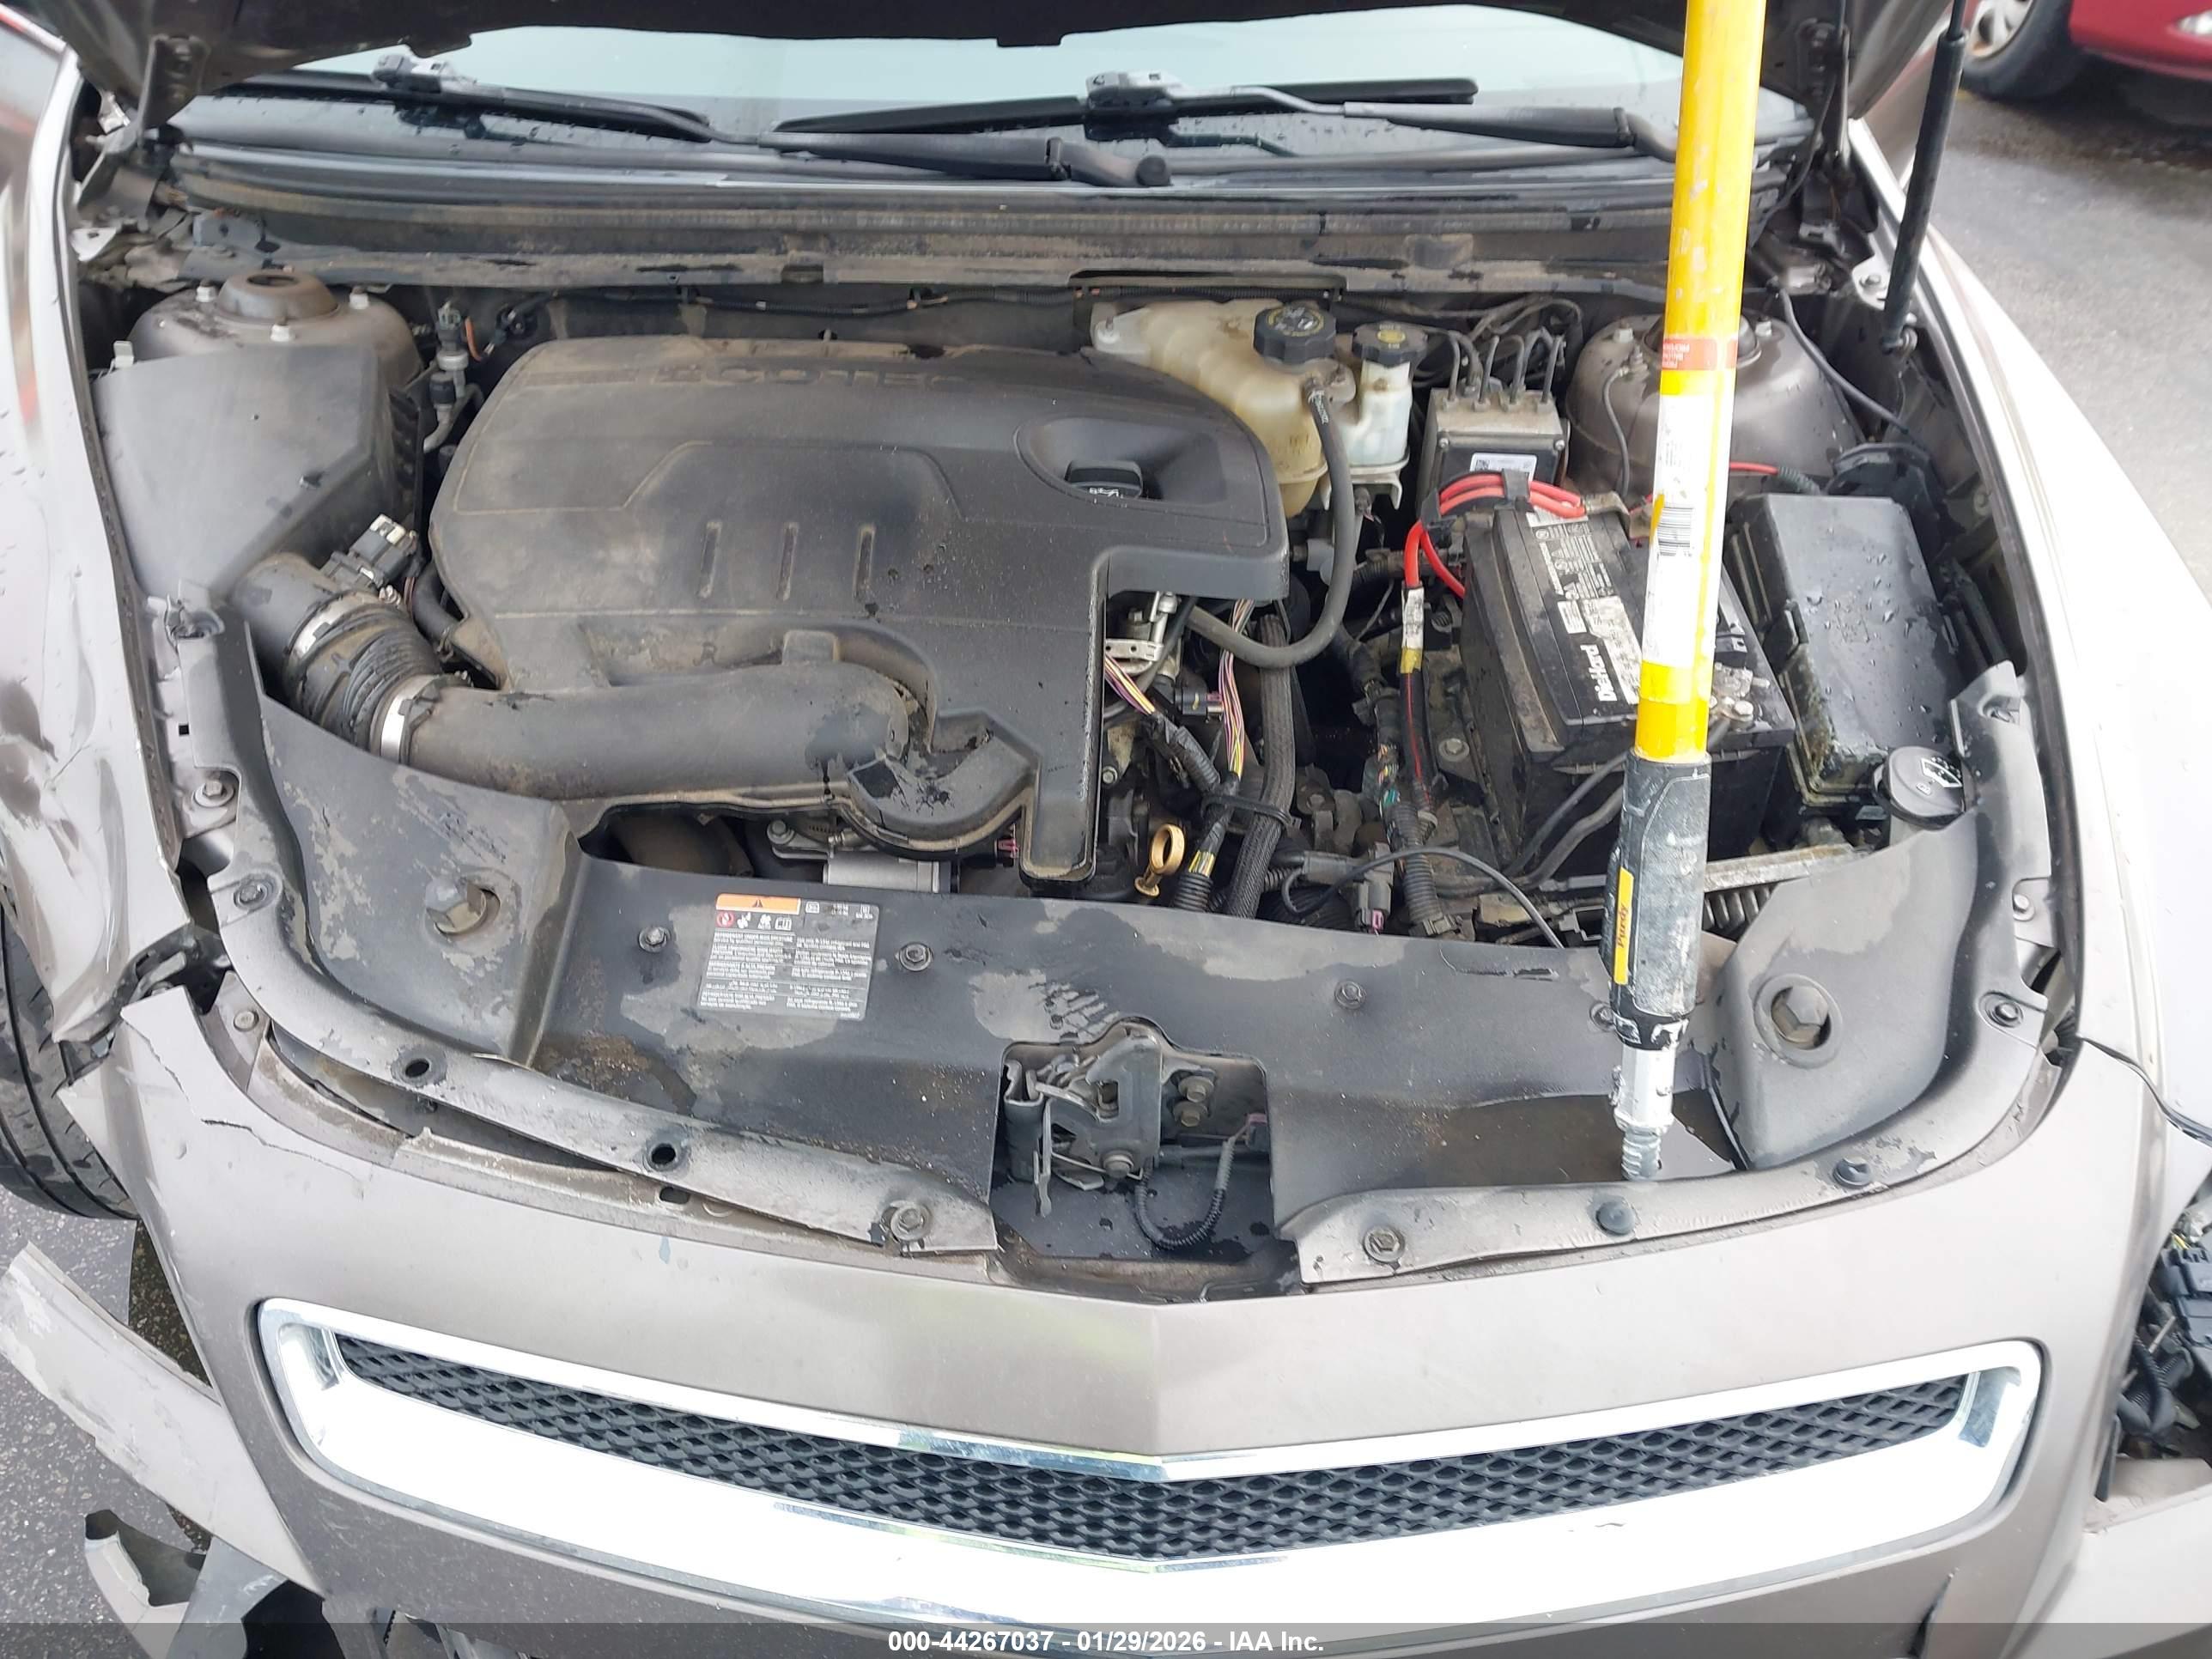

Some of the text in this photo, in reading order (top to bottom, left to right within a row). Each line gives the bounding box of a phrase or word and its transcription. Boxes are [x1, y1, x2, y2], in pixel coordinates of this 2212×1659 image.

[654, 365, 974, 389] ECOTEC
[1580, 644, 1618, 702] DieHard
[1617, 902, 1629, 949] Purdy
